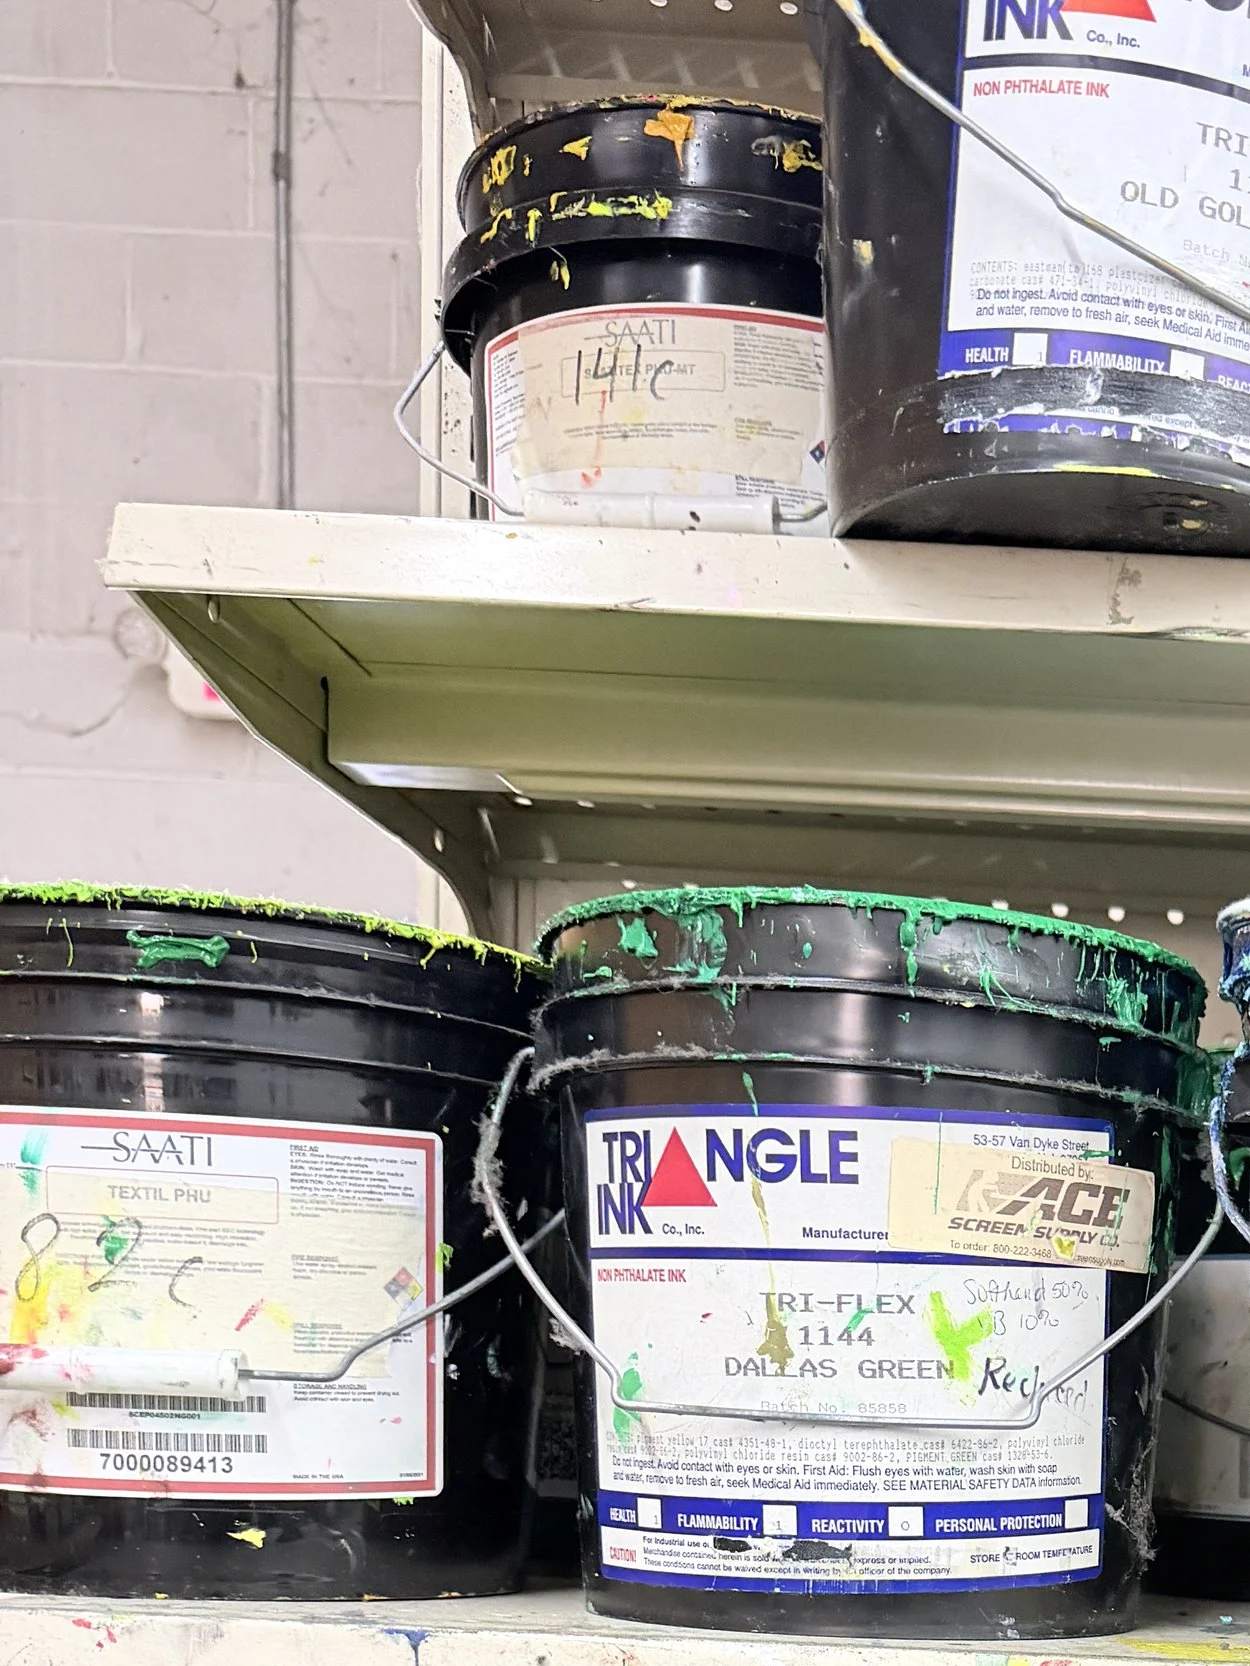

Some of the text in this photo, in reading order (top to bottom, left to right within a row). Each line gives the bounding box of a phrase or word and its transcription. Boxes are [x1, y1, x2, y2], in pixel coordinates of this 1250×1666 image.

[1117, 32, 1140, 48] Inc.
[973, 79, 1110, 98] NON PHTHALATE INK
[1120, 180, 1179, 209] OLD
[1183, 238, 1230, 264] Batch
[1081, 292, 1121, 306] contact
[605, 319, 676, 347] SAATI
[976, 304, 995, 316] and
[997, 305, 1027, 318] water,
[1030, 306, 1069, 318] remove
[1085, 308, 1112, 322] fresh
[1134, 314, 1160, 330] seek
[1162, 319, 1203, 338] Medical
[1204, 328, 1222, 343] Aid
[965, 347, 1166, 374] HEALTH FLAMMABILITY
[112, 1131, 213, 1167] SAATI
[973, 1135, 1089, 1151] 53-57 Van Dyke Street
[1012, 1156, 1094, 1180] Distributed by:
[107, 1185, 212, 1204] TEXTIL PHU
[996, 1177, 1130, 1229] ACE
[597, 1183, 705, 1236] INK Inc.
[963, 1241, 1051, 1259] order: 800-222-3468
[597, 1268, 686, 1283] NON PHTHALATE INK
[759, 1292, 915, 1315] TRI-FLEX
[798, 1326, 875, 1347] 1144
[724, 1357, 955, 1380] DALLAS GREEN
[858, 1403, 907, 1414] 85858
[99, 1453, 234, 1474] 7000089413
[852, 1463, 1058, 1479] Flush eyes wash skin soap
[883, 1477, 1037, 1491] SEE MATERIAL SAFETY DATA
[609, 1508, 1063, 1535] HEALTH FLAMMABILITY REACTIVITY PERSONAL PROTECTION
[609, 1547, 637, 1563] CAUTION!
[971, 1551, 1040, 1563] STORE ROOM
